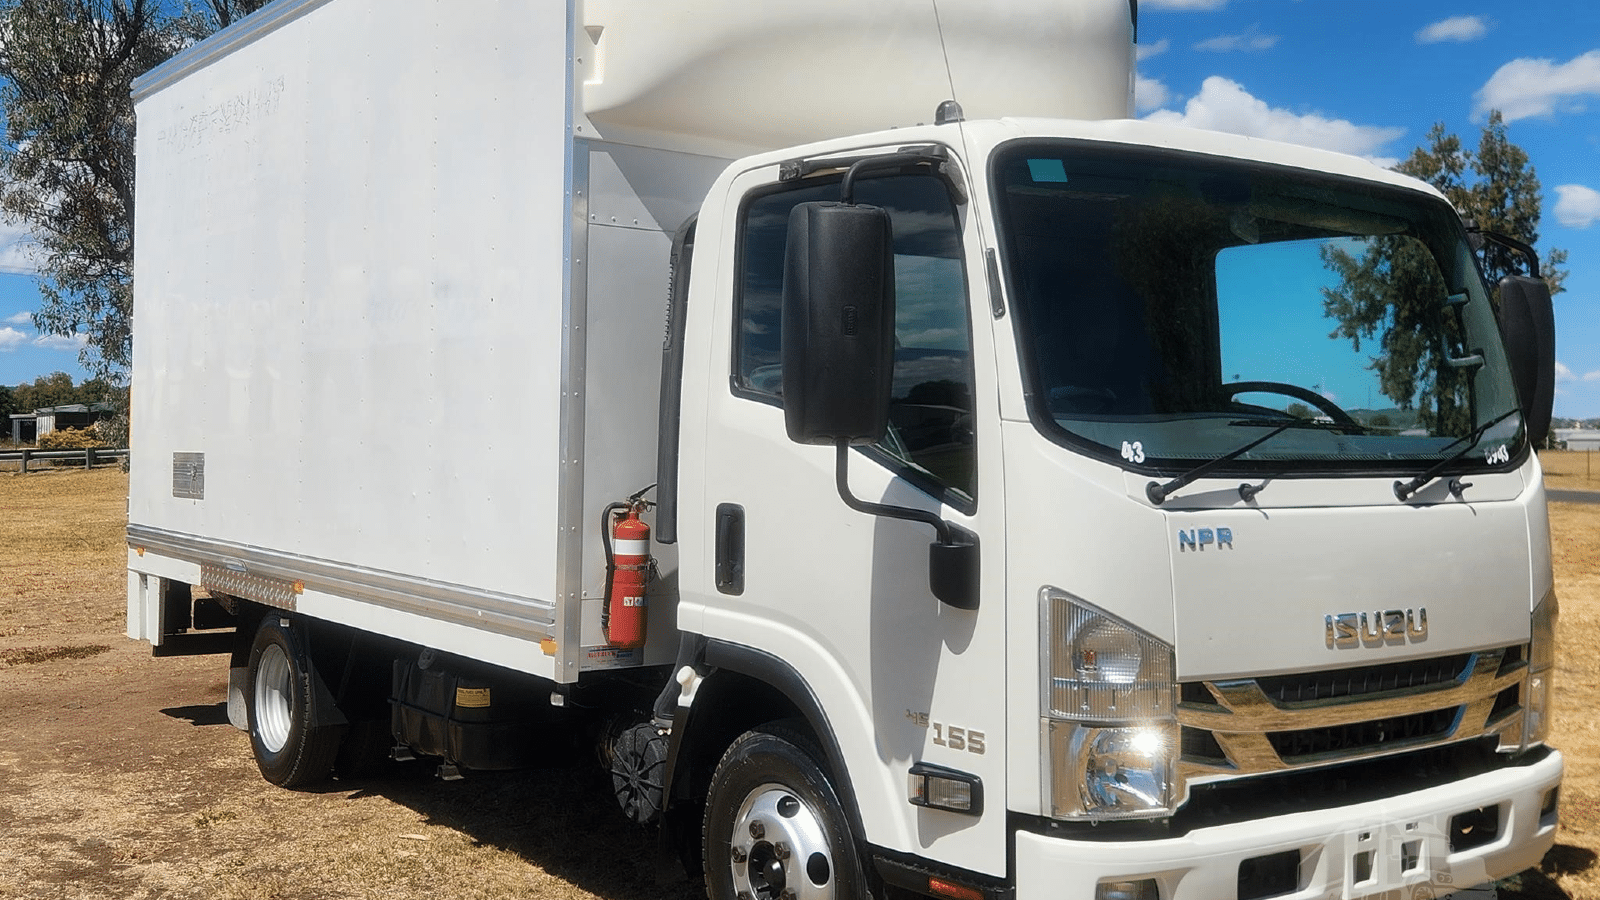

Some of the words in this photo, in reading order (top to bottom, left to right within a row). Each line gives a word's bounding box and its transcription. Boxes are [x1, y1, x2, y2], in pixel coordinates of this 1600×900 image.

[1120, 440, 1145, 463] 43
[1178, 527, 1233, 552] NPR
[1324, 607, 1428, 650] ISUZU
[932, 721, 986, 755] 155
